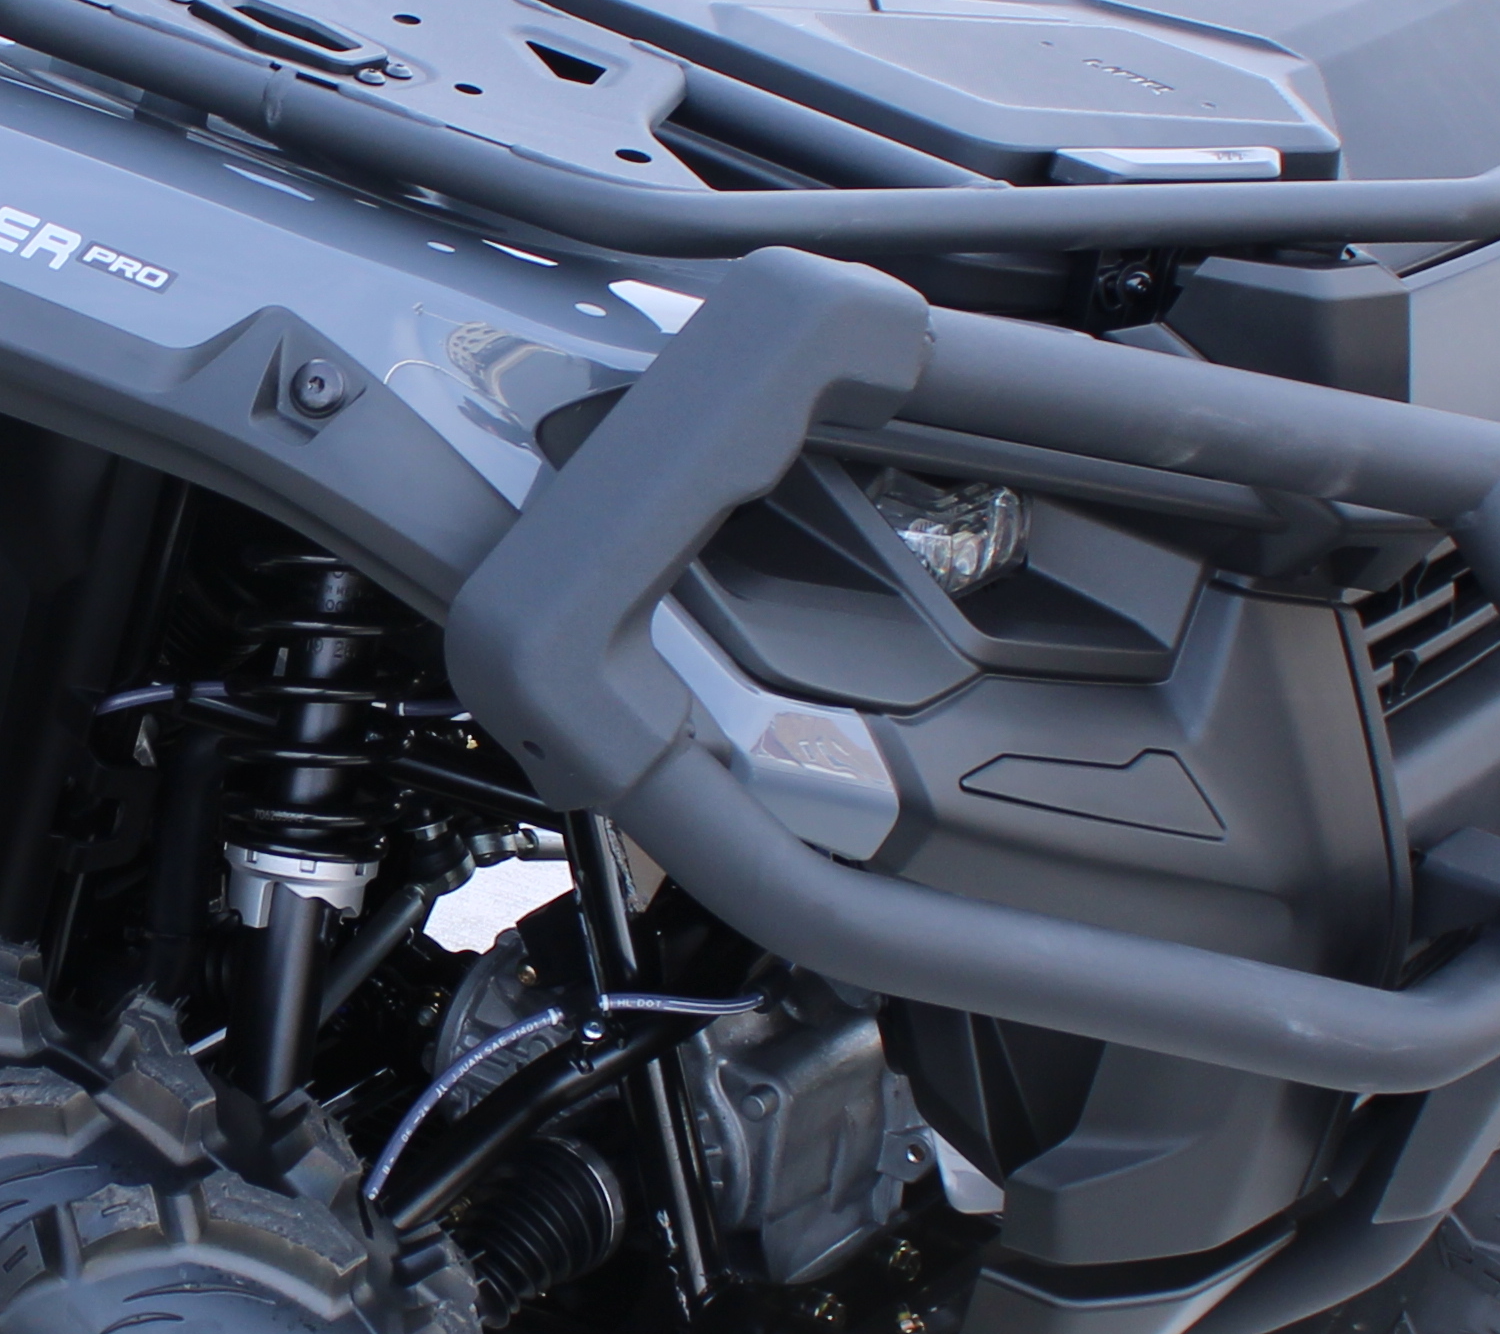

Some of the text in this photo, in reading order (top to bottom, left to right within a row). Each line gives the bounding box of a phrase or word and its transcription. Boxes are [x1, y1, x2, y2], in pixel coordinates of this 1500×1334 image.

[82, 245, 170, 290] PRO
[636, 998, 663, 1009] DOT
[484, 1036, 507, 1055] SAE
[510, 1021, 540, 1041] J1401
